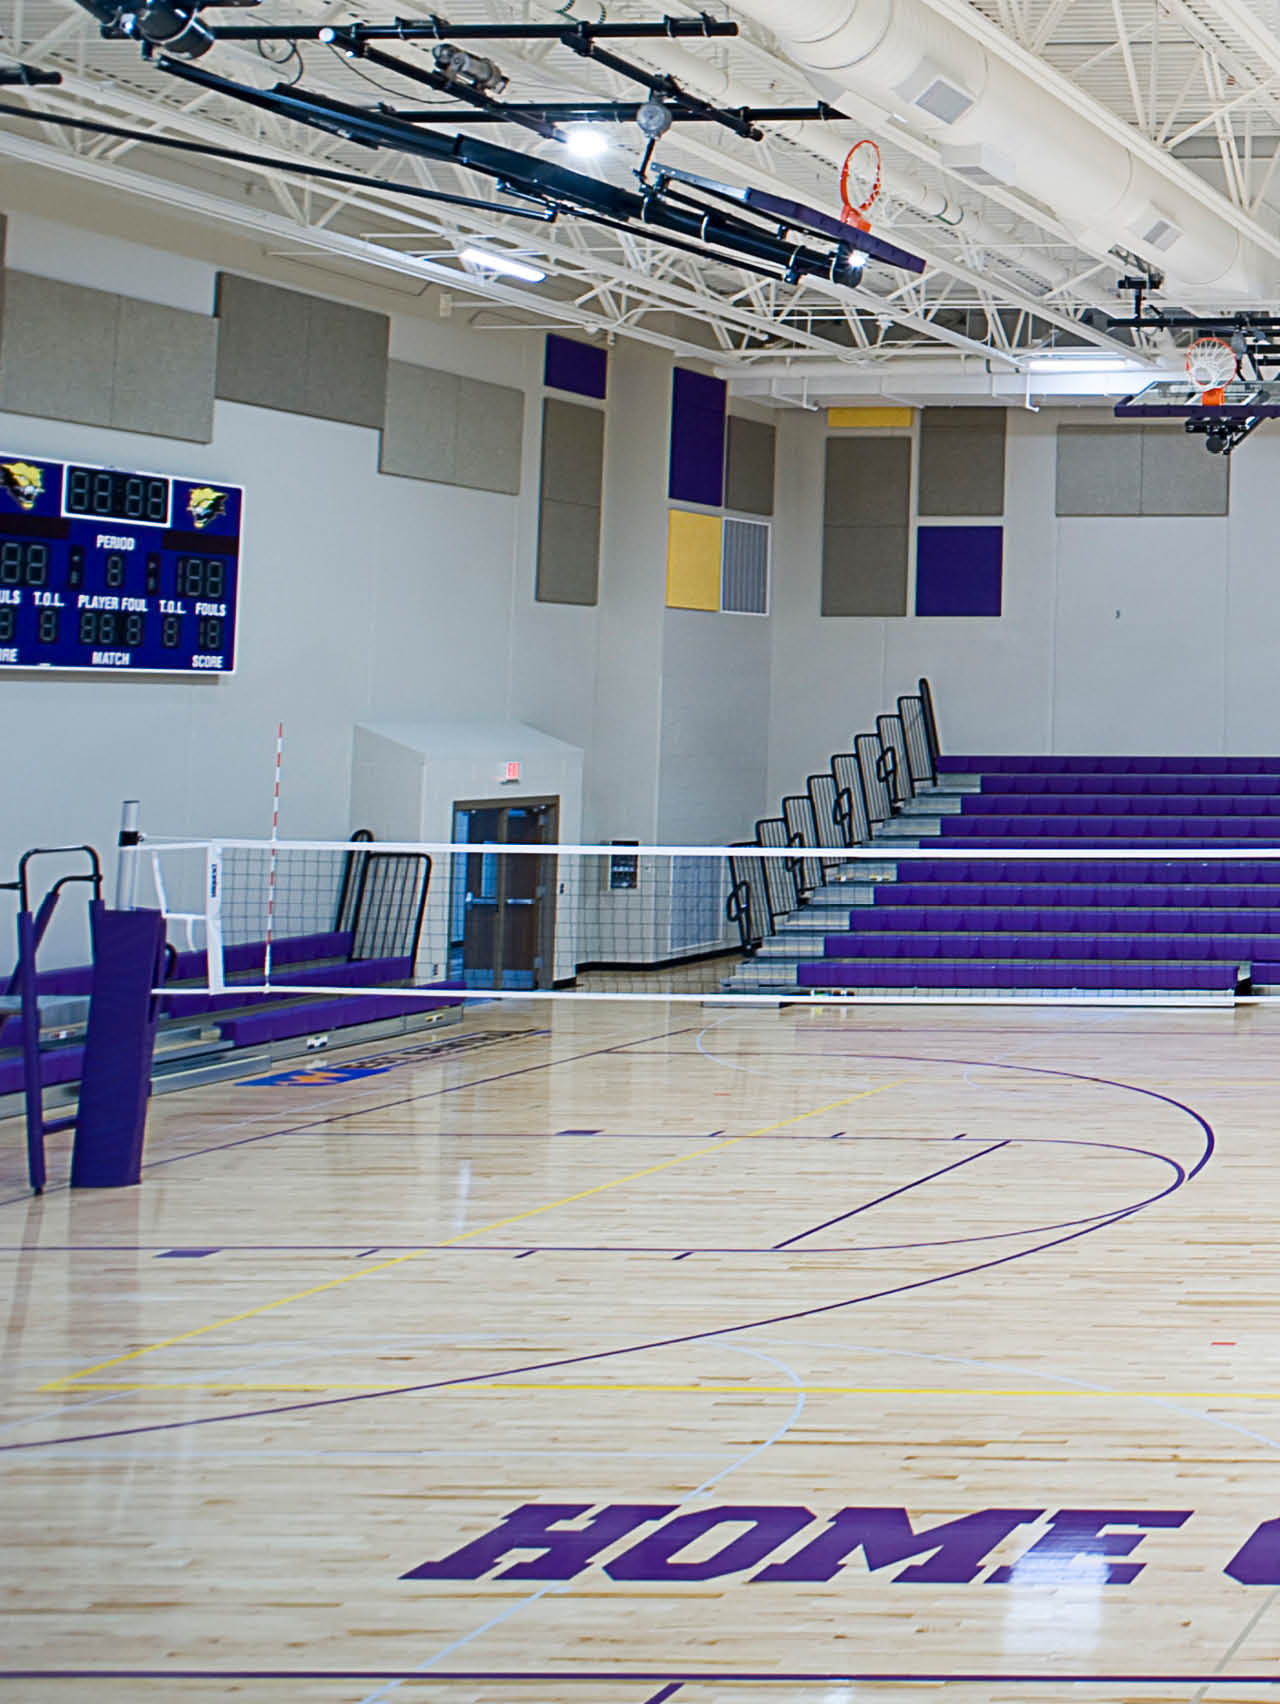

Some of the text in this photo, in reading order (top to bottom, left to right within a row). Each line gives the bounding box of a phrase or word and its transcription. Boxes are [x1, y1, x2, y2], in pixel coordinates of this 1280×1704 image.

[97, 534, 136, 550] PERIOD
[77, 594, 148, 612] PLAYER FOUL
[195, 602, 227, 616] FOULS
[92, 651, 131, 665] MATCH
[191, 654, 224, 668] SCORE
[404, 1504, 1193, 1585] HOME
